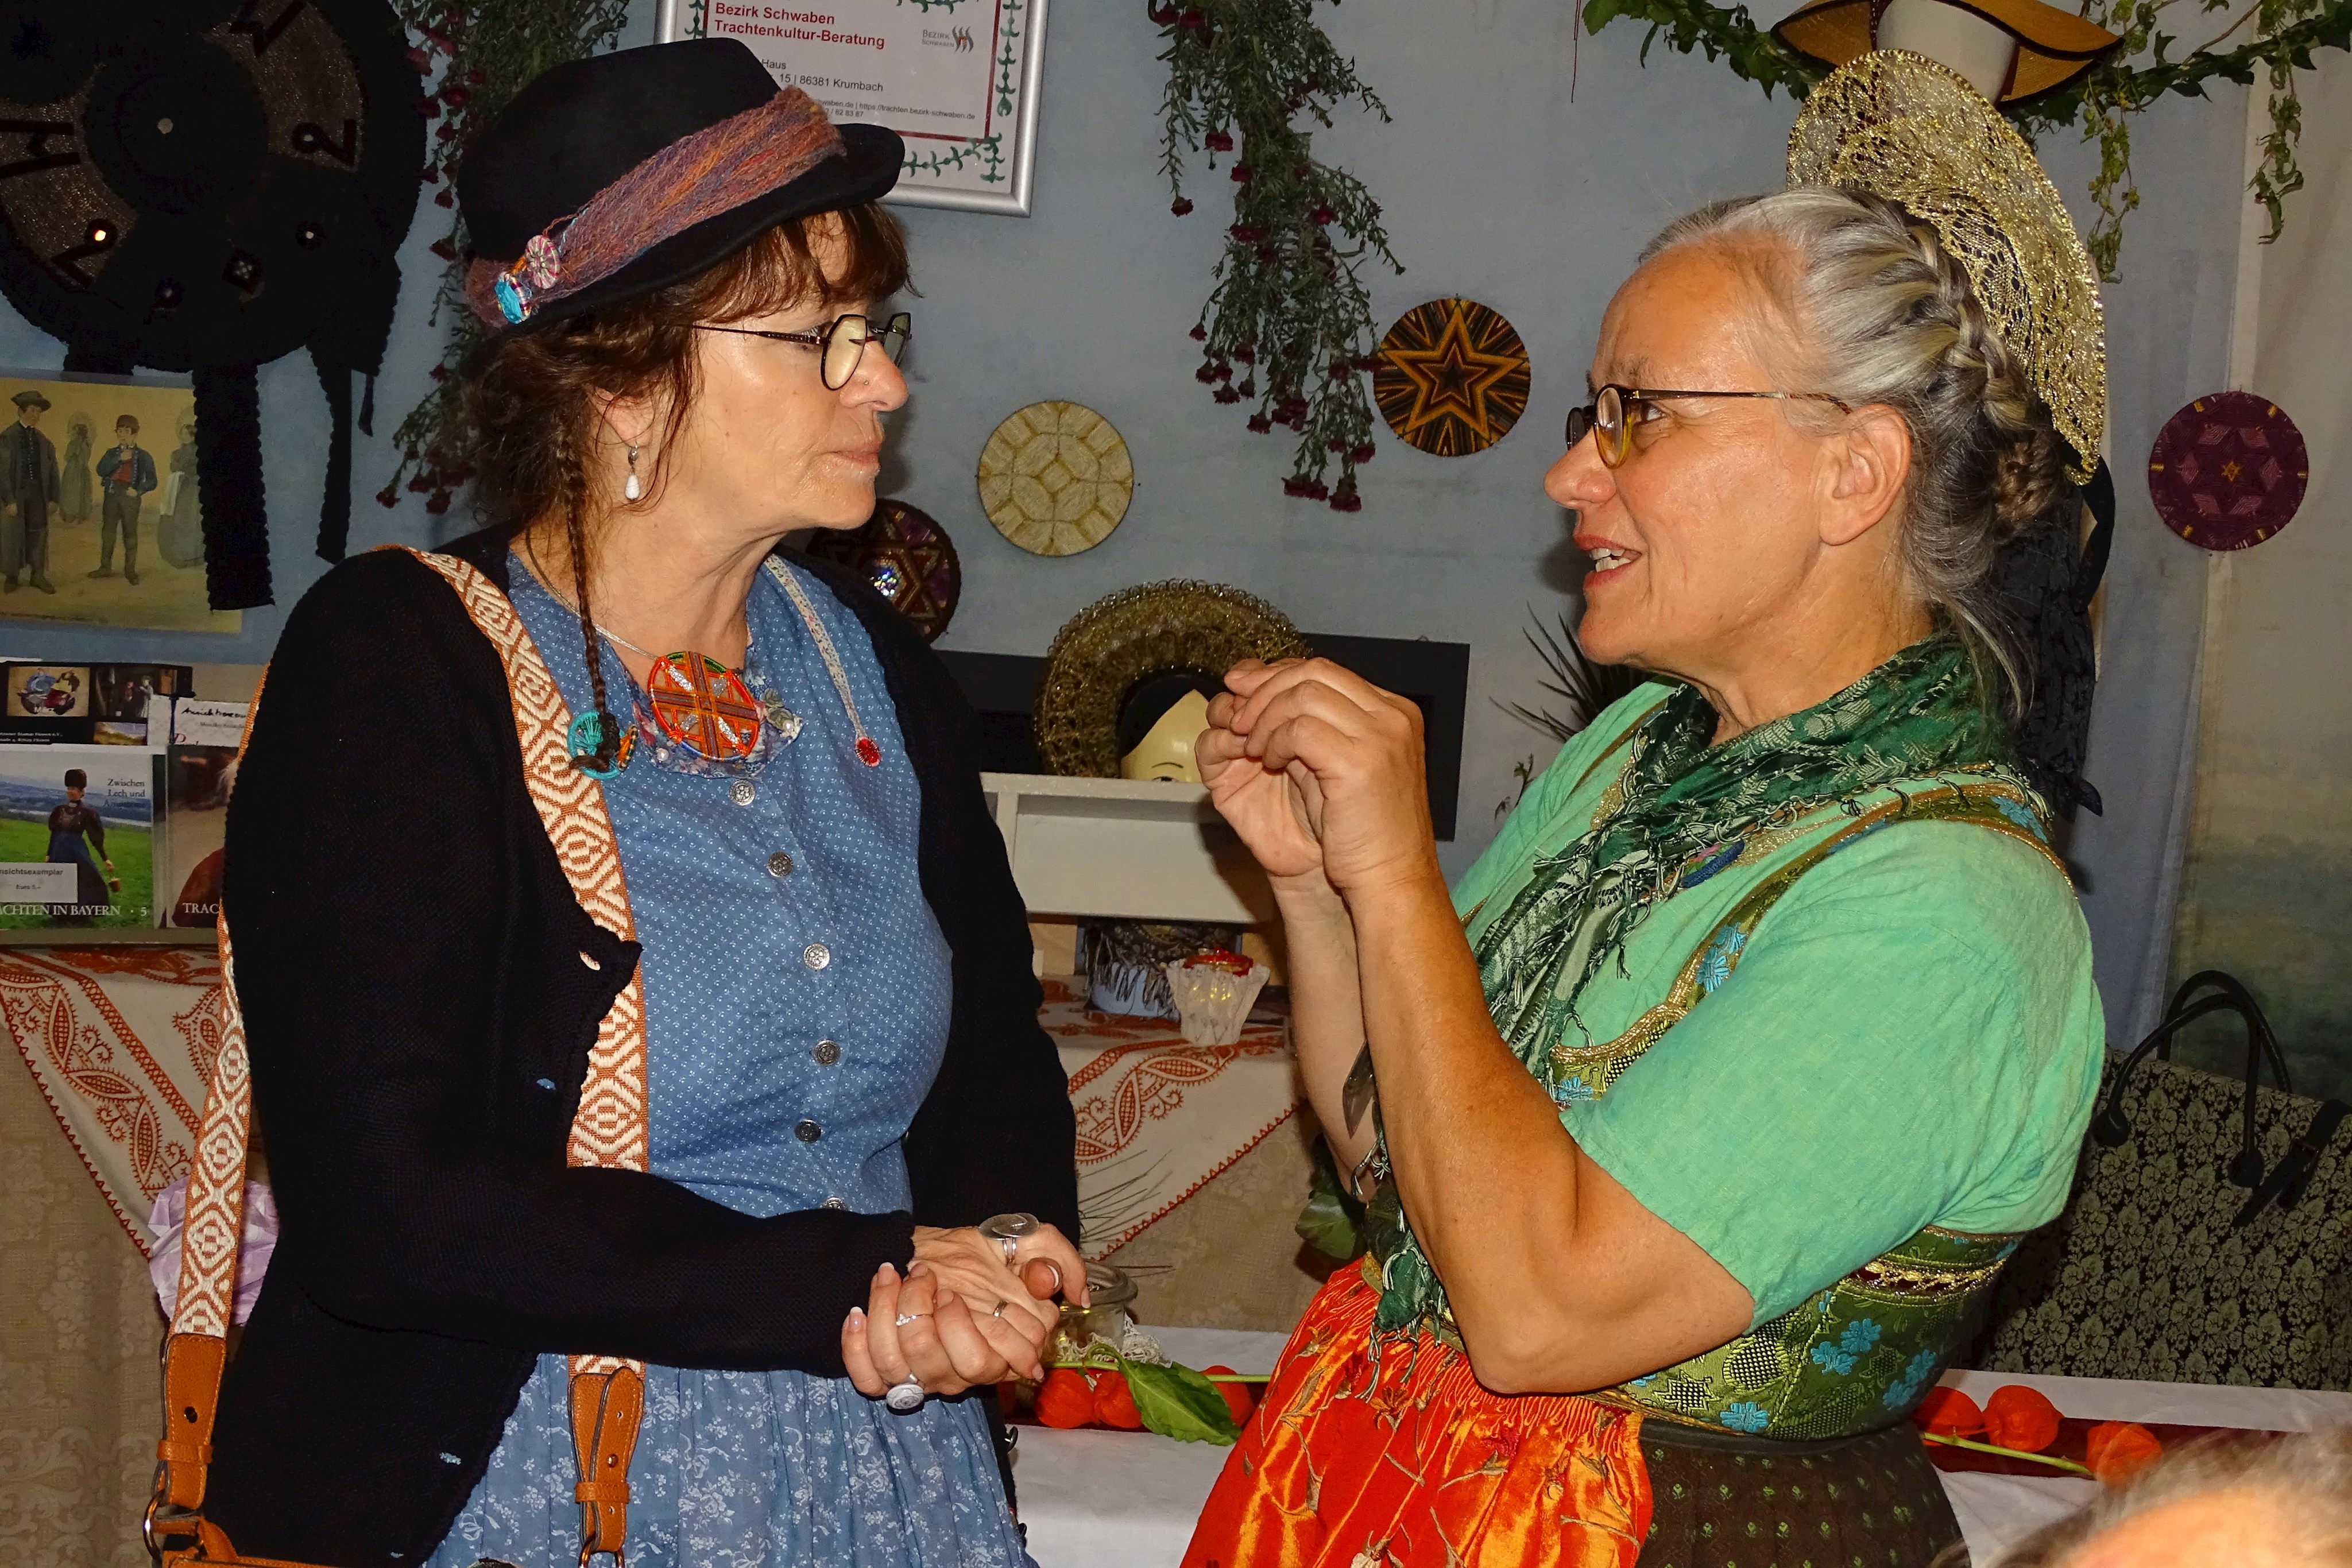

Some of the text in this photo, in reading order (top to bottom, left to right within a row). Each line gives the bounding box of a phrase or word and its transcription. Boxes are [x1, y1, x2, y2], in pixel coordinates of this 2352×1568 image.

[715, 2, 835, 25] Bezirk Schwaben
[715, 20, 885, 50] Trachtenkultur-Beratung
[761, 59, 787, 69] Haus
[780, 73, 791, 83] 15
[800, 75, 829, 87] 86381
[833, 79, 884, 92] Krumbach
[107, 779, 145, 787] Zwischen
[108, 789, 127, 797] Lech
[0, 904, 50, 916] CHTEN
[53, 905, 68, 916] IN
[70, 905, 121, 916] BAYERN
[140, 907, 147, 916] 5
